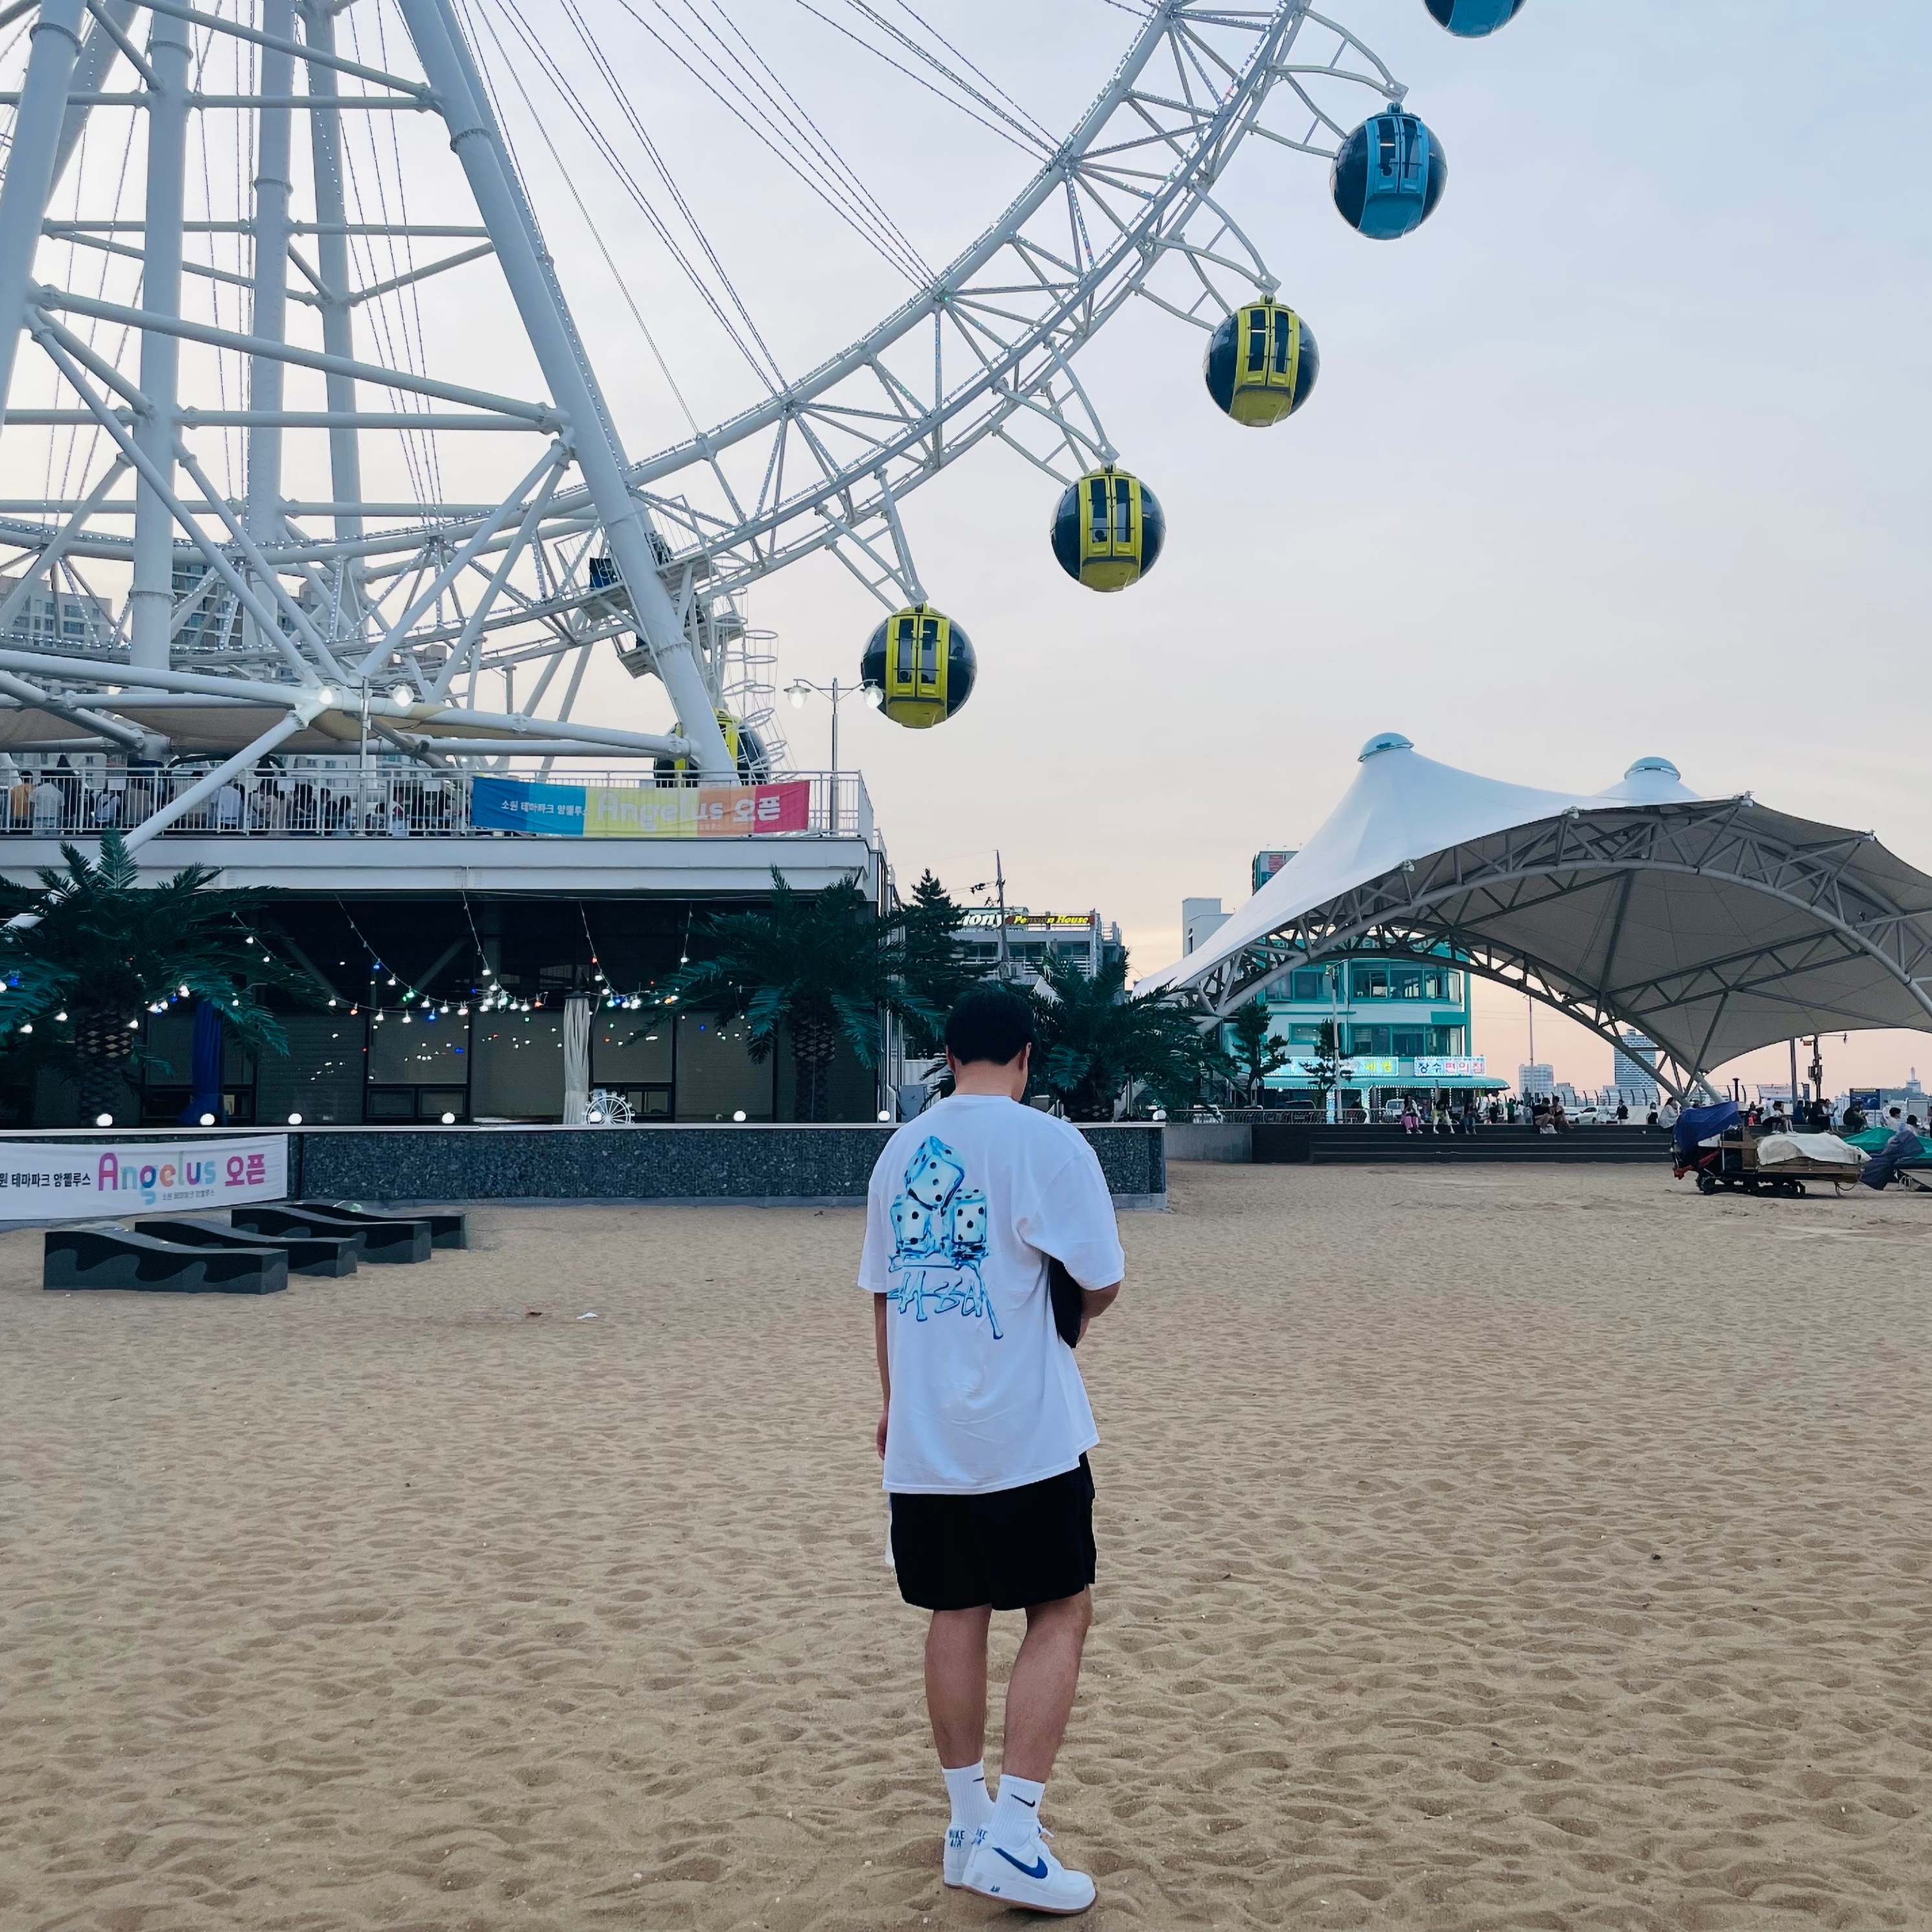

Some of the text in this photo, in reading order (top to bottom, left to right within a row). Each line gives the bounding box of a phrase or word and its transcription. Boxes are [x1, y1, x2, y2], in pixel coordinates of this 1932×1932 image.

[598, 792, 724, 833] Angelus
[733, 795, 781, 822] 오픈
[12, 1173, 51, 1188] 테마파크
[98, 1151, 216, 1205] Angelus
[225, 1154, 266, 1187] 오픈
